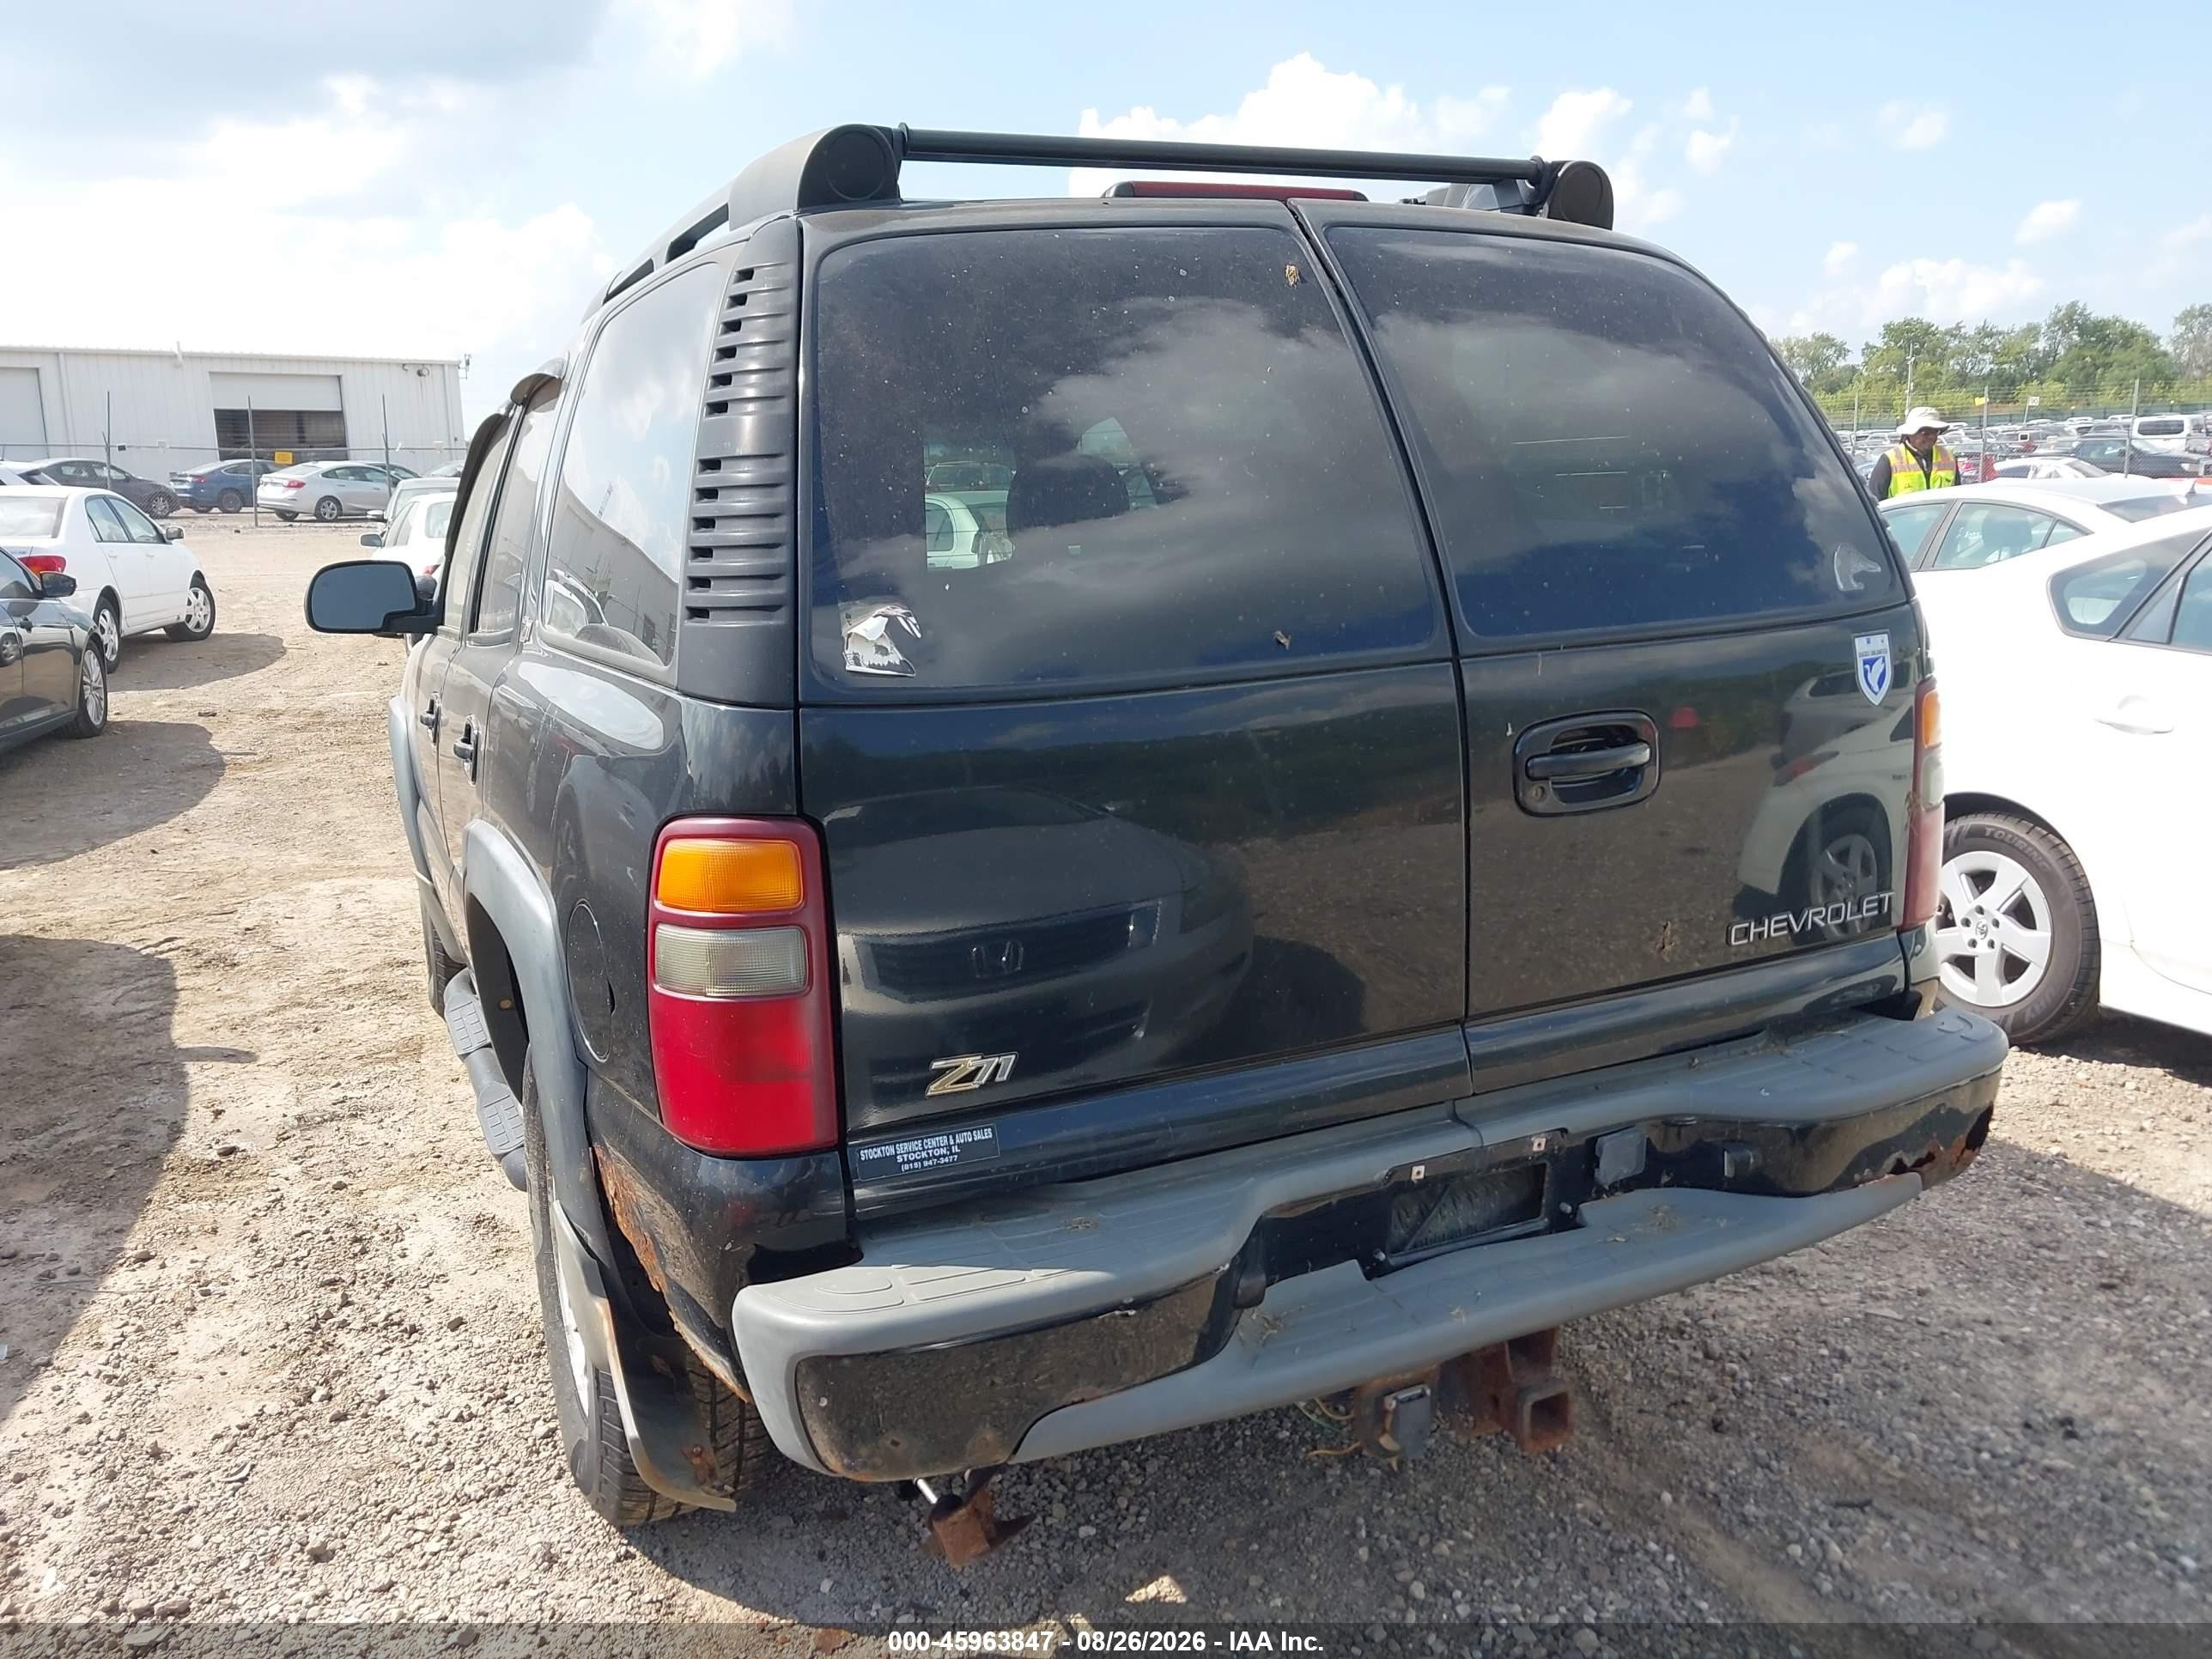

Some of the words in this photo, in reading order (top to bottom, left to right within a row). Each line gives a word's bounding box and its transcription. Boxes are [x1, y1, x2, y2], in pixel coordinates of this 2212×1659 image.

[1729, 891, 1896, 946] CHEVROLET
[926, 1054, 1017, 1097] Z71
[860, 1147, 896, 1162] STOCKTON
[896, 1140, 923, 1154] SERVICE
[923, 1135, 949, 1150] CENTER
[949, 1134, 955, 1145] &
[955, 1131, 973, 1145] AUTO
[973, 1127, 994, 1140] SALES
[951, 1145, 962, 1153] IL
[901, 1161, 921, 1172] (815)
[923, 1154, 959, 1168] 947-3477
